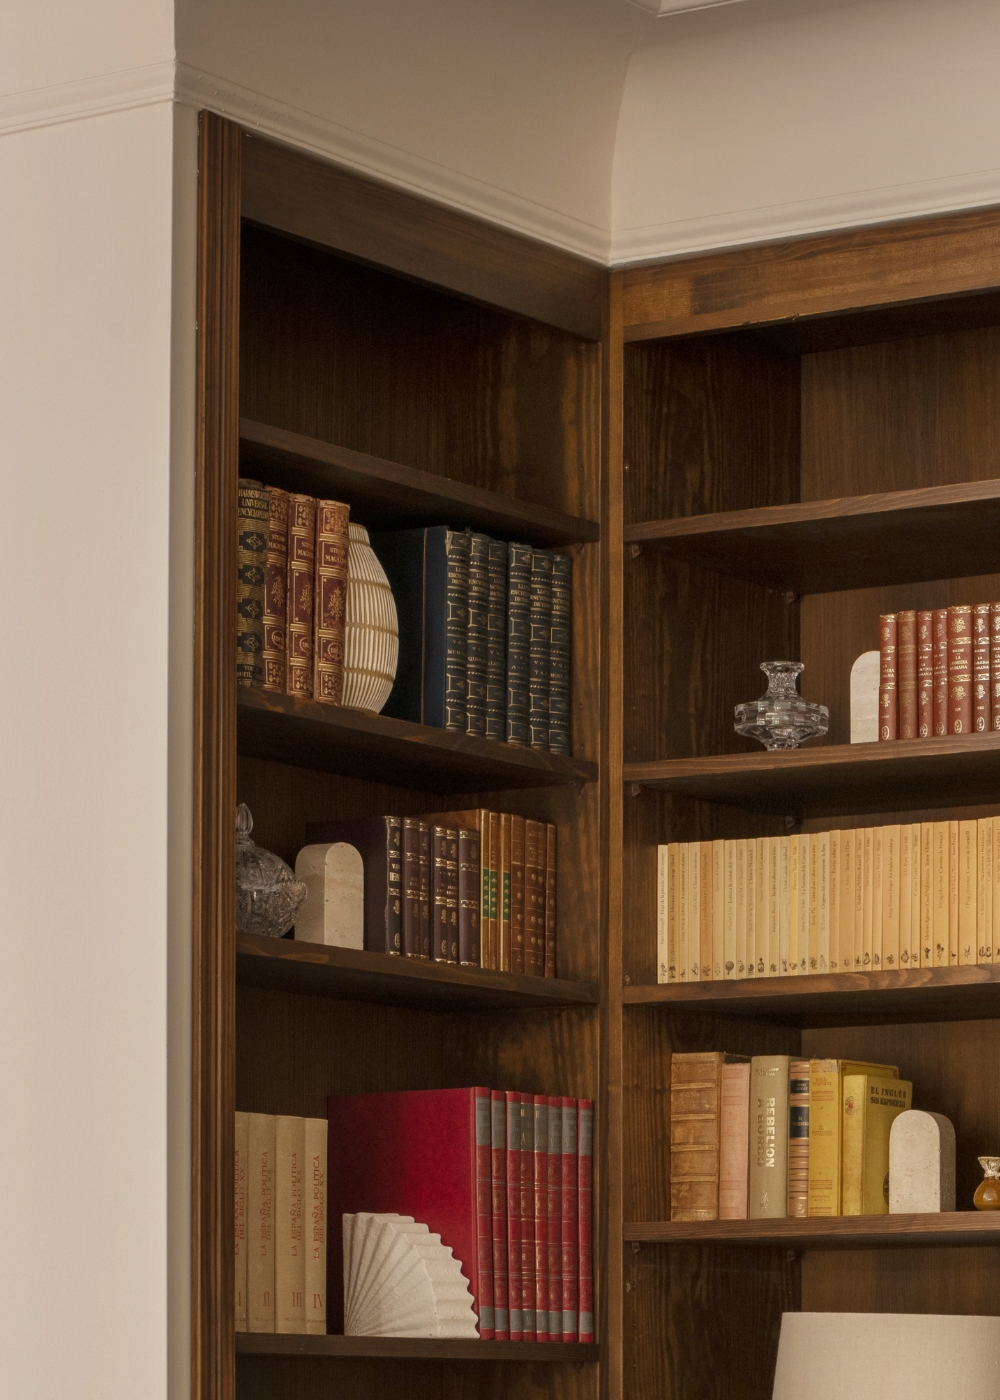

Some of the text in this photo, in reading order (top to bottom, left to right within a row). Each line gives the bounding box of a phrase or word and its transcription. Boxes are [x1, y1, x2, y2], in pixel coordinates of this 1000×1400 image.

[870, 1086, 906, 1098] EL INGLÉS
[758, 1098, 764, 1108] A
[870, 1096, 906, 1108] SIN ESFUERZO
[765, 1097, 776, 1167] REBELION
[240, 1168, 244, 1181] XX
[261, 1245, 266, 1257] LA
[292, 1245, 297, 1257] LA
[314, 1248, 319, 1259] LA
[238, 1292, 241, 1306] I
[263, 1292, 270, 1306] II
[292, 1292, 302, 1307] III
[313, 1294, 324, 1308] IV
